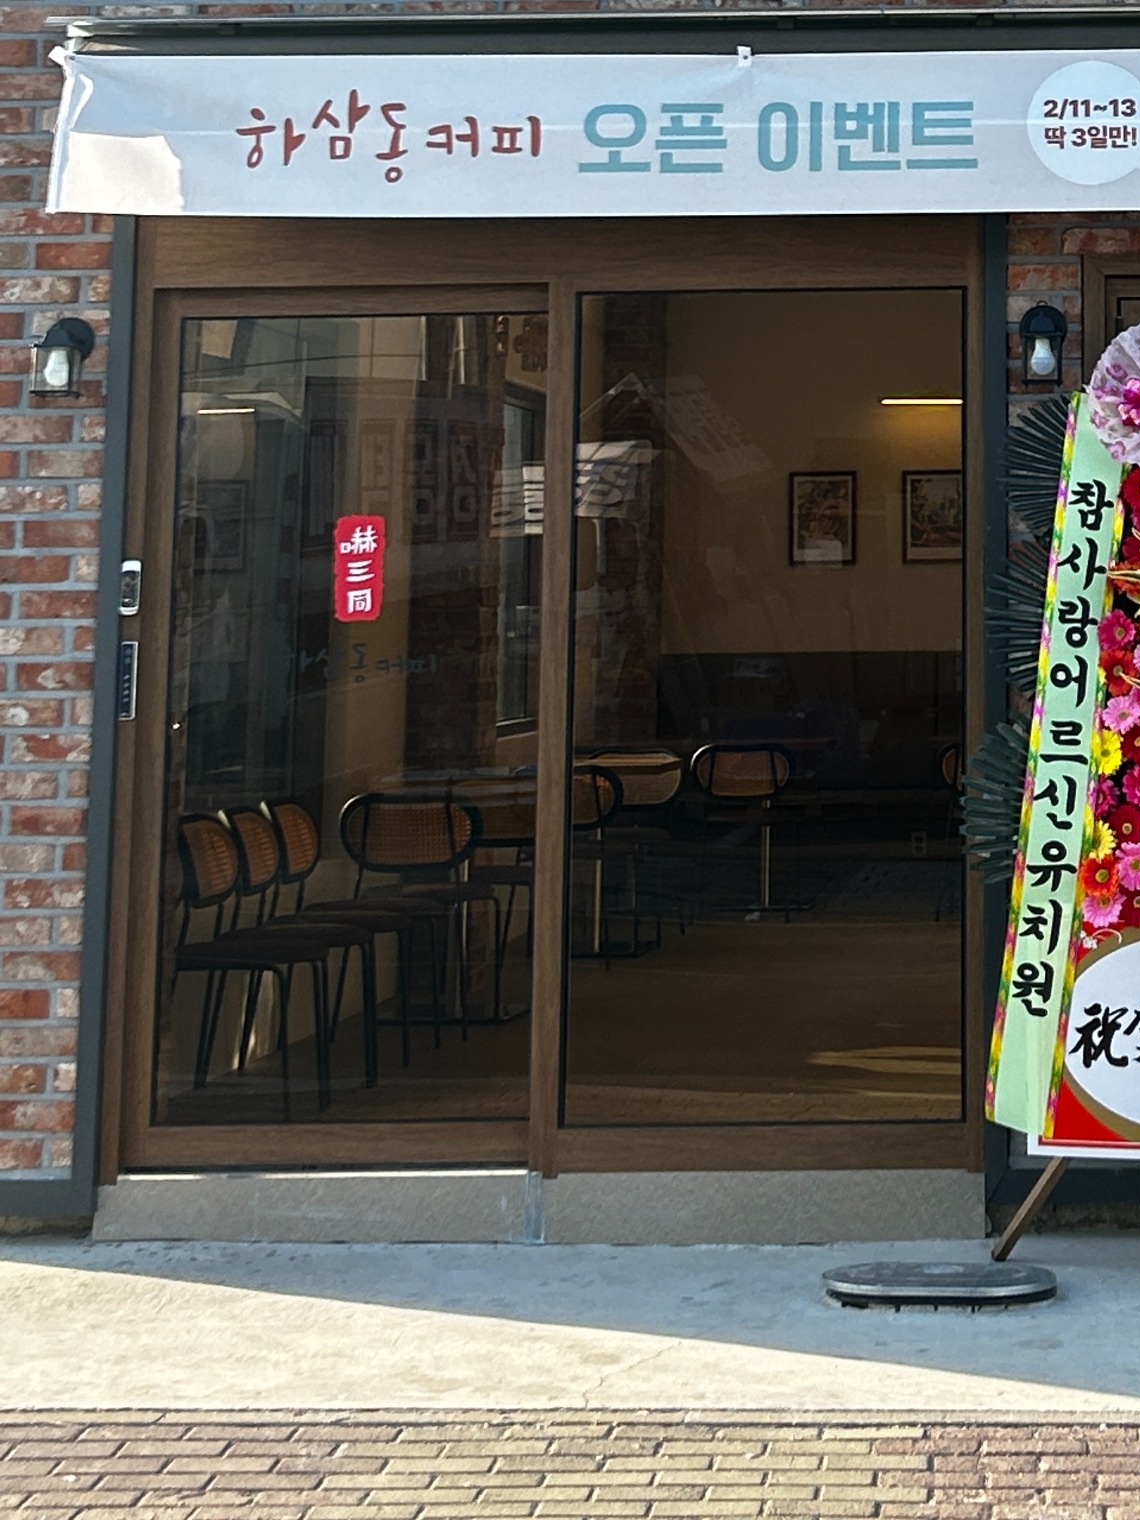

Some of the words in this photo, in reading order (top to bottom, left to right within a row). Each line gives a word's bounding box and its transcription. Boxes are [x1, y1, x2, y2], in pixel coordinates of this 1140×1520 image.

[1043, 98, 1137, 120] 2/11~13
[578, 101, 728, 174] 오픈
[757, 100, 979, 172] 이벤트
[1044, 126, 1067, 150] 딱
[1071, 125, 1137, 149] 3일만!
[340, 525, 379, 614] 嚇三同
